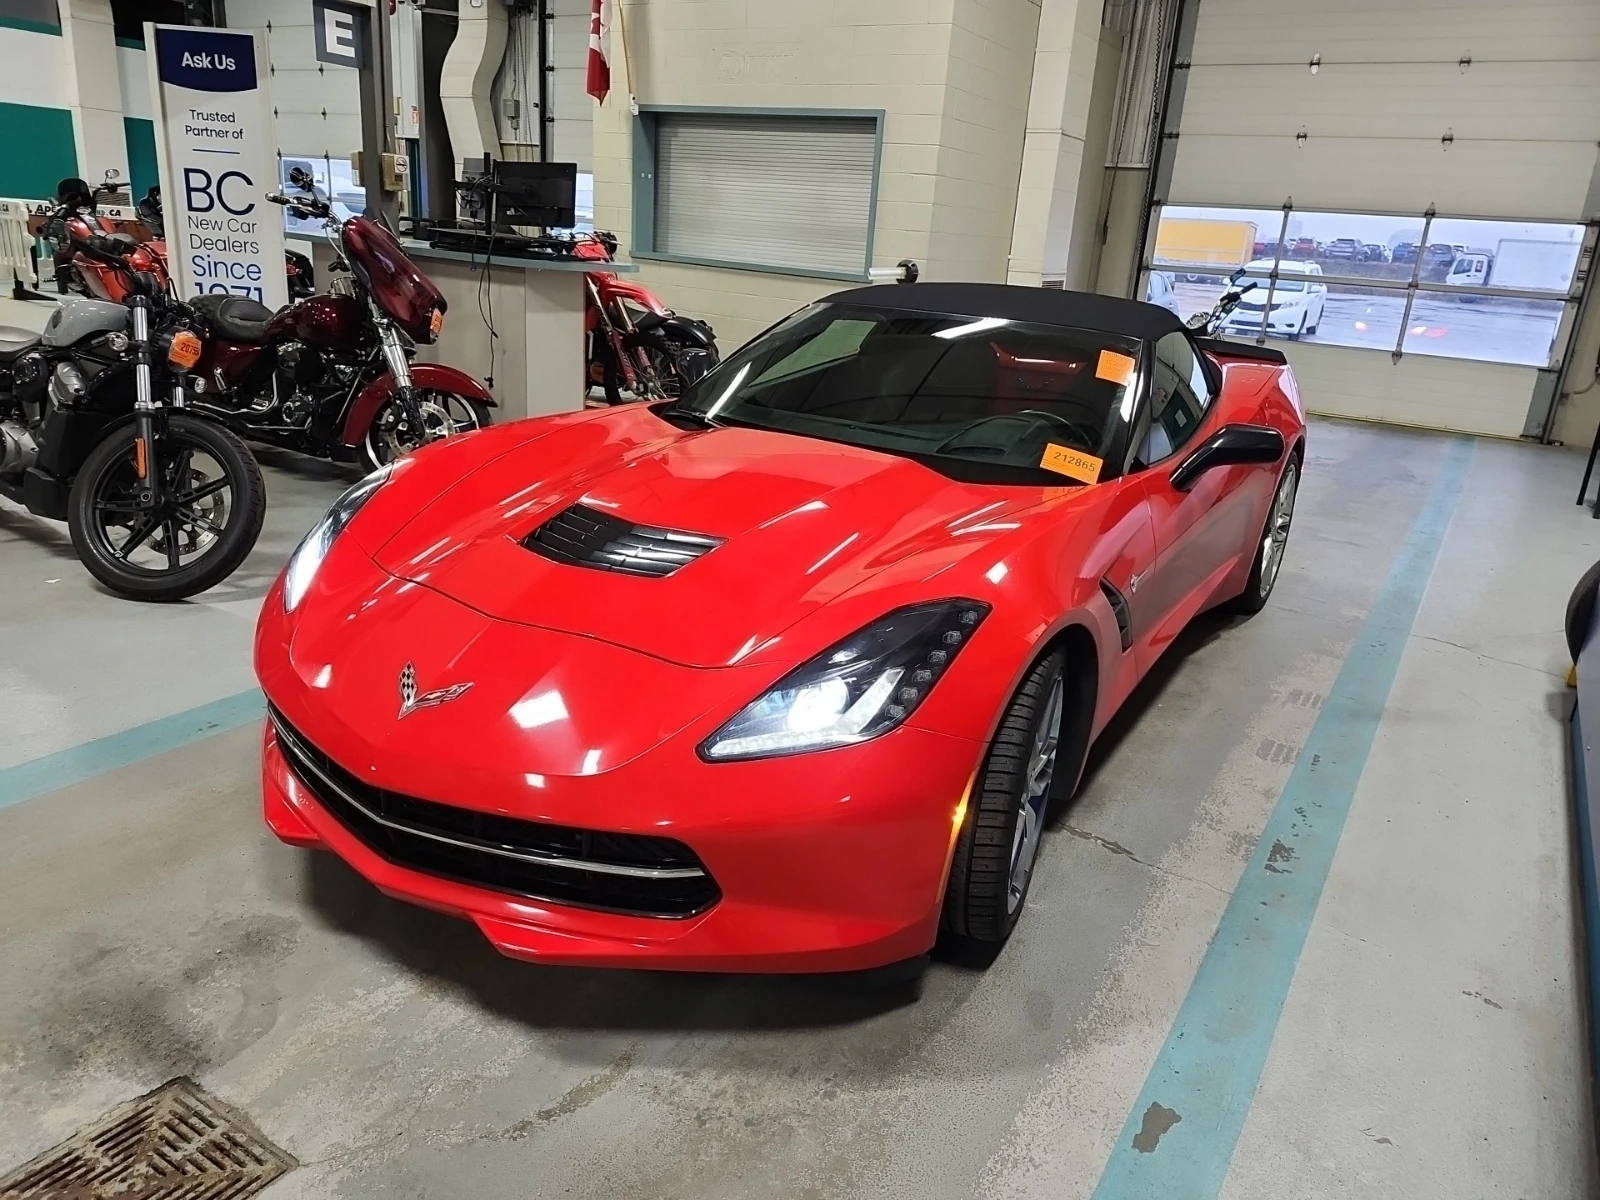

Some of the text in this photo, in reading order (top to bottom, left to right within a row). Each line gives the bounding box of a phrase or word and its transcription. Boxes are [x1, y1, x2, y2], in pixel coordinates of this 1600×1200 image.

[324, 8, 356, 59] E
[181, 51, 237, 71] Ask Us
[189, 109, 236, 124] Trusted
[185, 125, 244, 140] Partner of
[183, 168, 256, 216] BC
[188, 215, 258, 235] New Car
[190, 233, 260, 255] Dealers
[192, 254, 262, 282] Since
[1053, 451, 1096, 472] 212865
